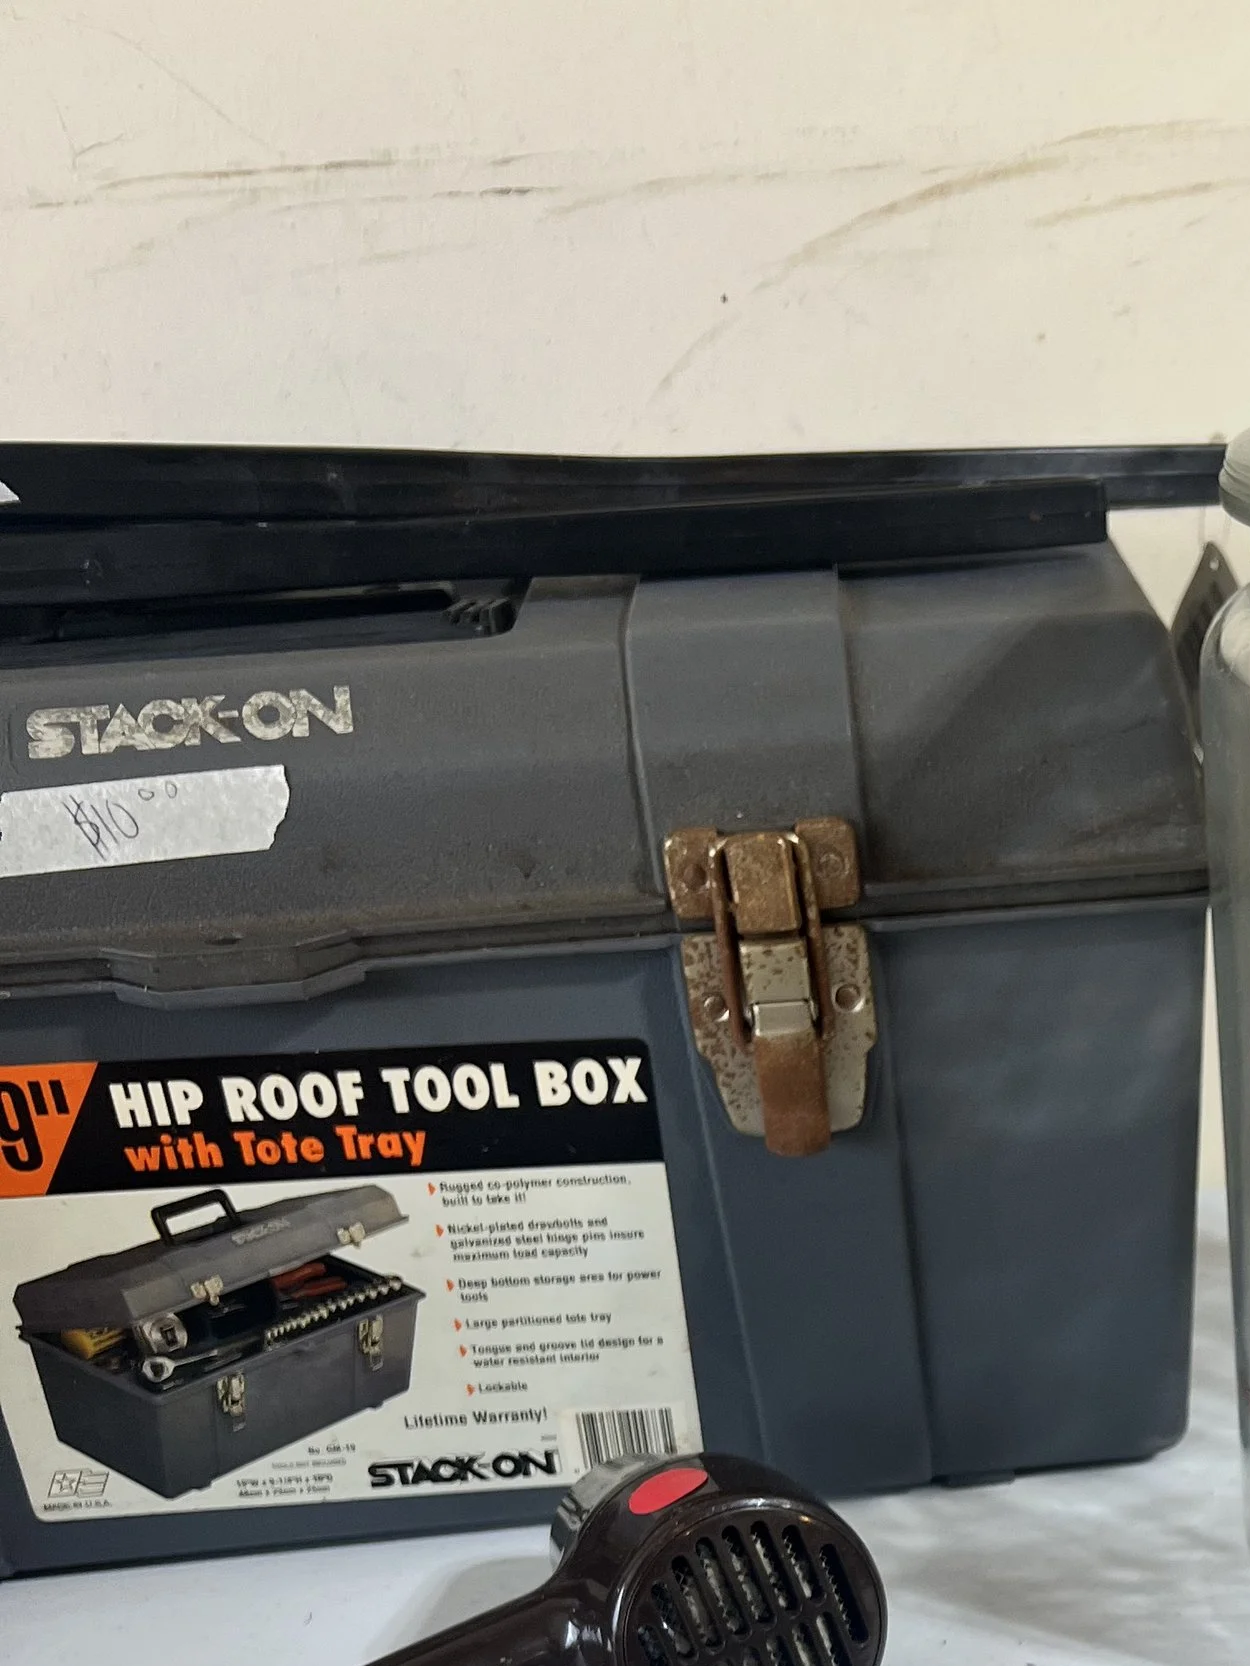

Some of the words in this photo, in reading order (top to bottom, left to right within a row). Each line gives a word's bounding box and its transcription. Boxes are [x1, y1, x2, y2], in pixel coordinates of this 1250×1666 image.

[26, 685, 354, 760] STACK-ON
[109, 1079, 203, 1129] HIP
[221, 1070, 364, 1122] ROOF
[380, 1062, 520, 1114] TOOL
[533, 1056, 648, 1107] BOX
[125, 1131, 224, 1172] with
[233, 1130, 324, 1167] Tote
[335, 1124, 426, 1167] Tray
[440, 1181, 483, 1194] Rugged
[443, 1196, 467, 1206] built
[471, 1196, 483, 1206] to
[486, 1194, 510, 1204] take
[587, 1216, 608, 1227] and
[516, 1234, 543, 1245] steel
[582, 1232, 606, 1243] pins
[453, 1251, 509, 1261] maximum
[513, 1249, 537, 1259] load
[542, 1246, 588, 1258] capacity
[459, 1278, 487, 1291] Deep
[492, 1276, 530, 1288] bottom
[534, 1274, 575, 1287] storage
[580, 1274, 604, 1282] area
[608, 1270, 623, 1281] for
[627, 1269, 661, 1282] power
[461, 1292, 488, 1303] tools
[466, 1319, 498, 1331] Large
[566, 1313, 587, 1324] tote
[591, 1312, 612, 1325] tray
[471, 1344, 512, 1355] Tongue
[516, 1342, 535, 1353] and
[580, 1338, 595, 1349] lid
[599, 1338, 635, 1349] design
[639, 1336, 653, 1346] for
[474, 1358, 504, 1368] water
[508, 1354, 556, 1365] resistant
[479, 1381, 528, 1393] Lockable
[404, 1412, 468, 1430] Lifetime
[472, 1407, 548, 1427] Warranty!
[368, 1449, 559, 1488] STACK-ON
